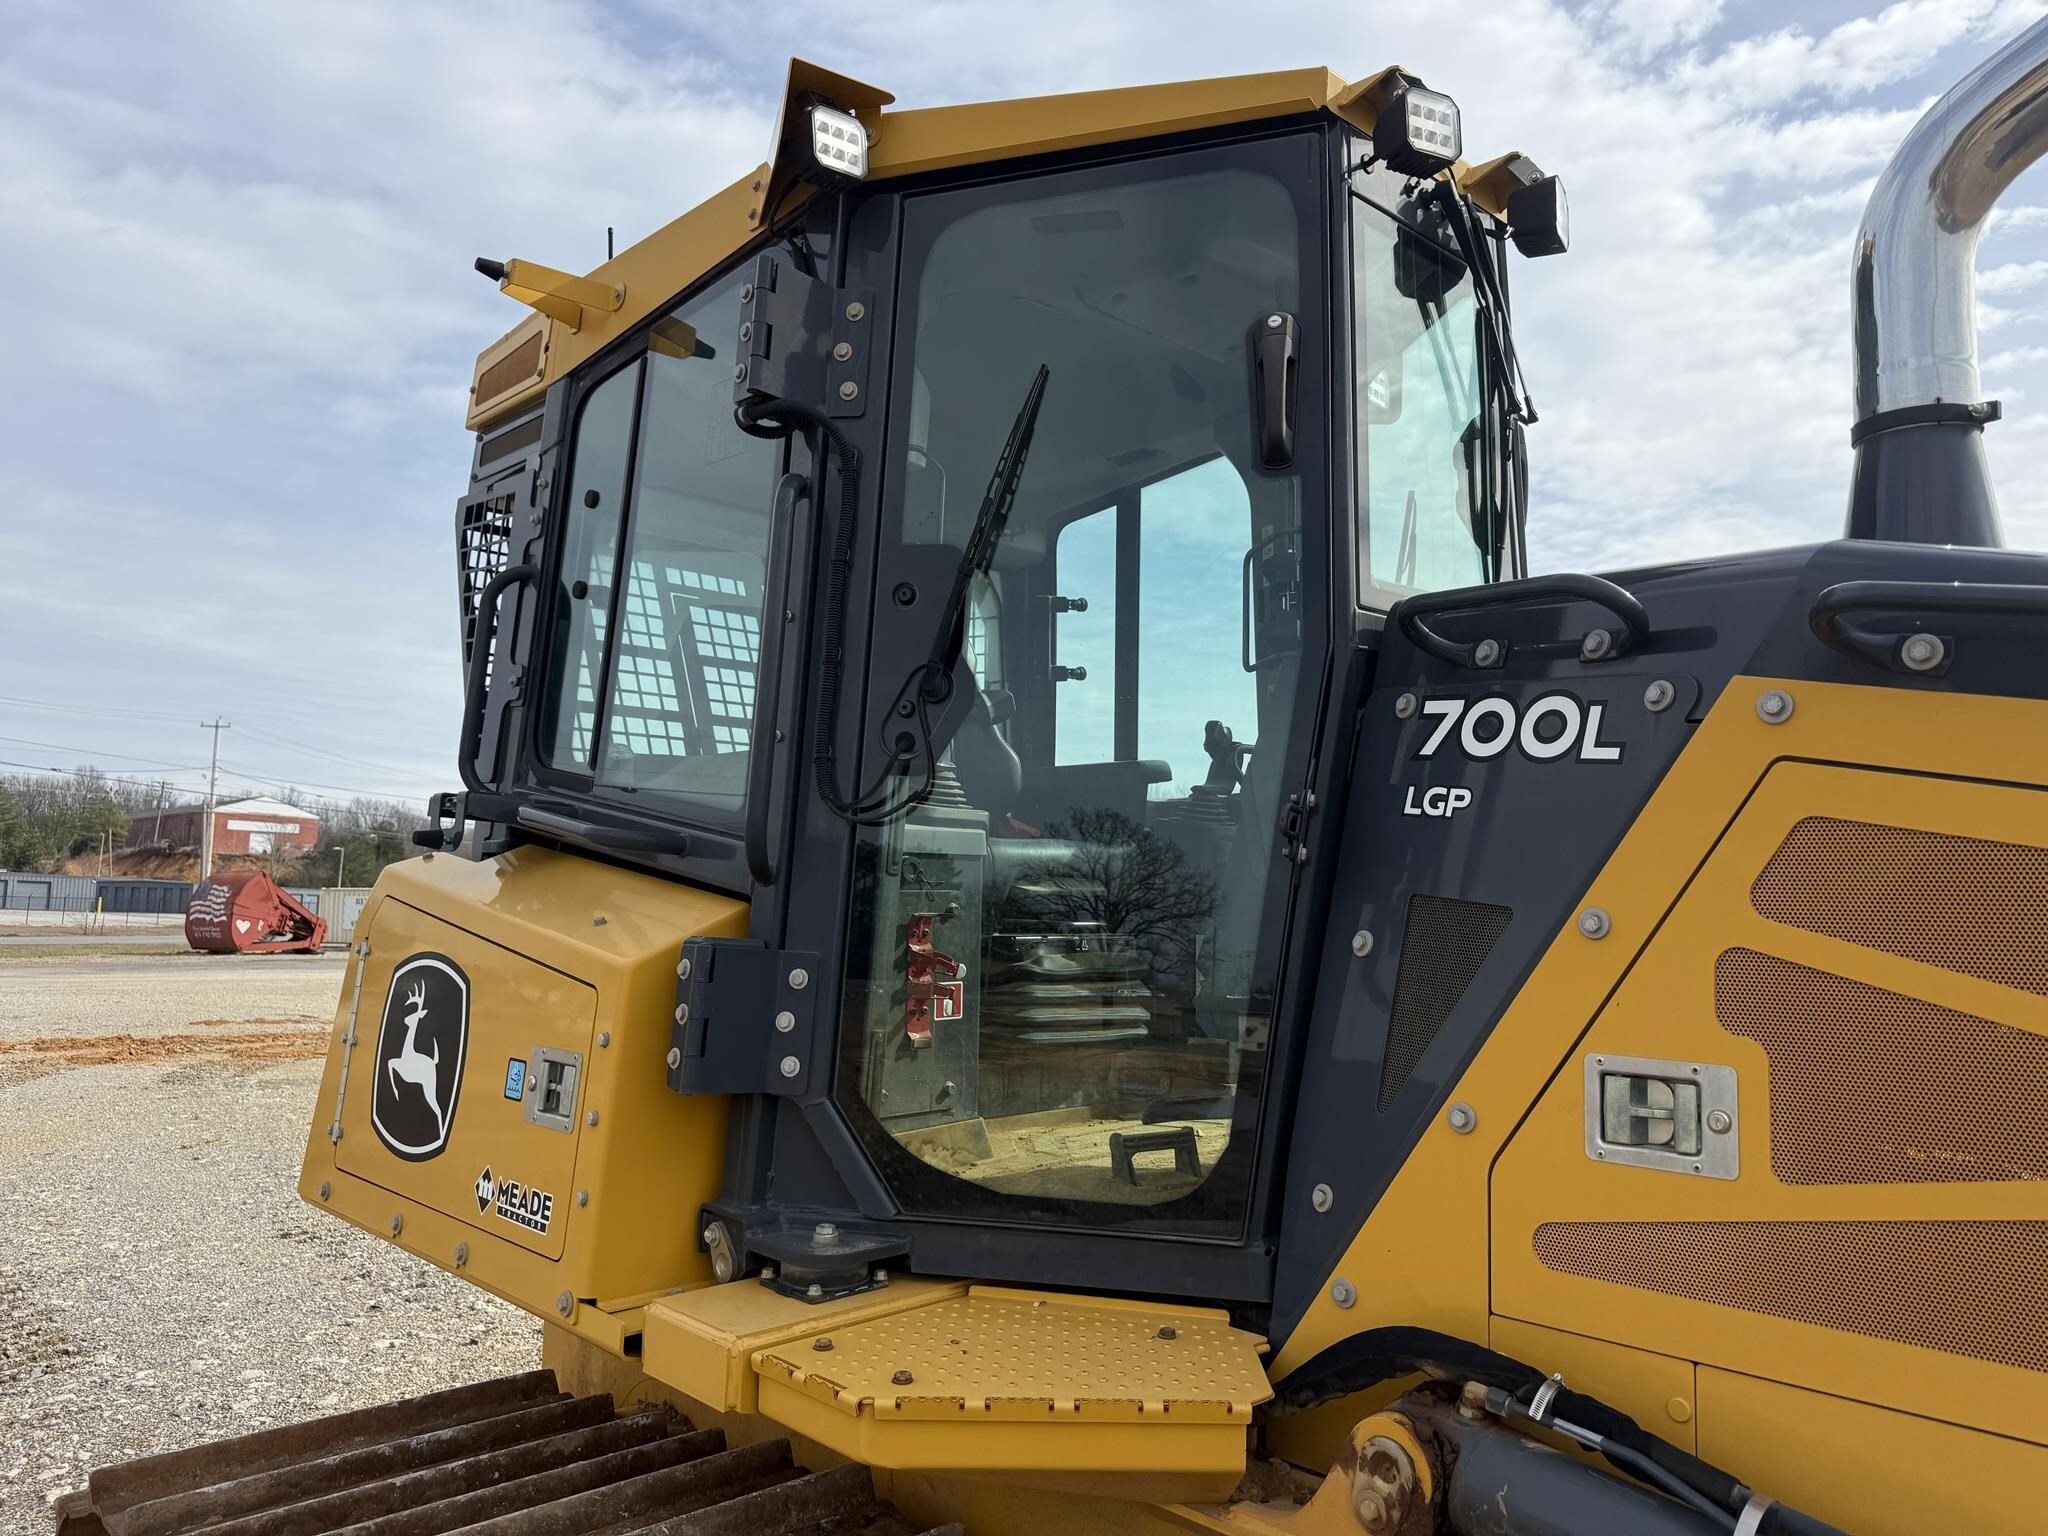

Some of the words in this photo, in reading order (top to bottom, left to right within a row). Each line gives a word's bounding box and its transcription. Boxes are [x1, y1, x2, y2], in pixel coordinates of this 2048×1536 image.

[1419, 695, 1621, 760] 700L
[1403, 785, 1472, 818] LGP
[496, 1177, 553, 1222] MEADE
[501, 1207, 542, 1231] TRACTOR
